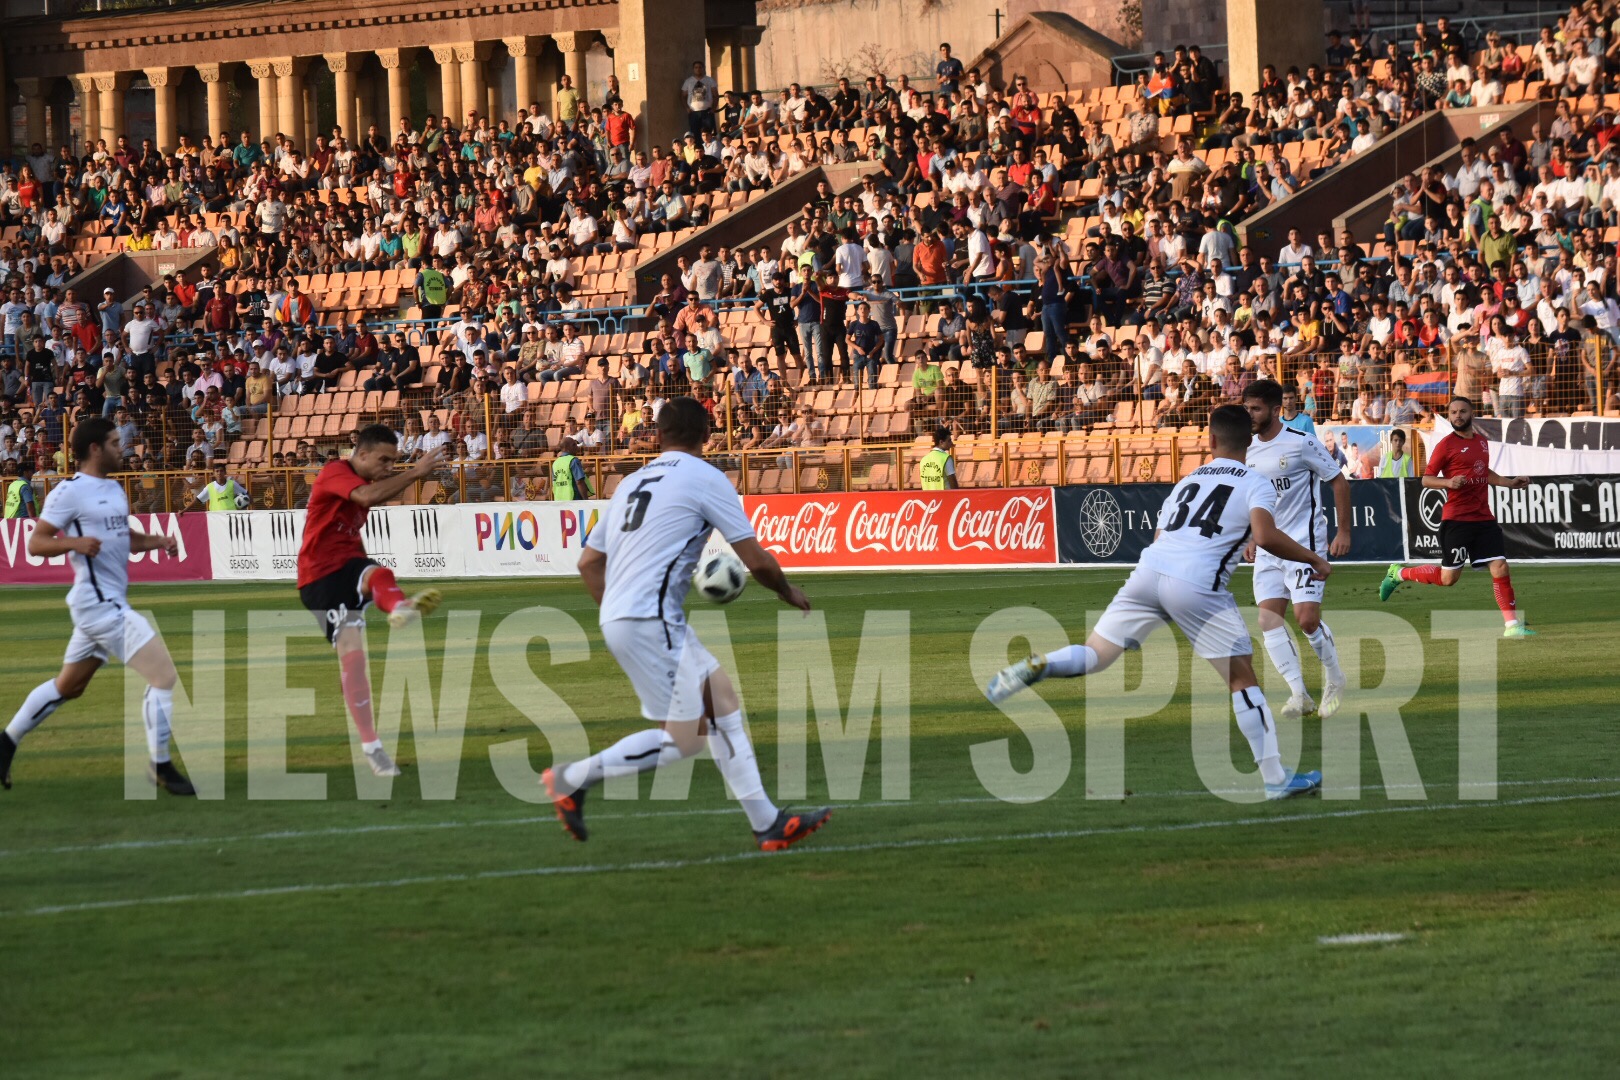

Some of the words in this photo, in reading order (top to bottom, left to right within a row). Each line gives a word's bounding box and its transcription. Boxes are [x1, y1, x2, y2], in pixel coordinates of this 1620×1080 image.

[620, 475, 665, 533] 5
[1164, 482, 1235, 539] 34
[750, 501, 841, 555] Coca-Cola
[845, 499, 943, 554] Coca-Cola
[947, 496, 1050, 552] Coca-Cola
[1554, 532, 1603, 549] FOOTBALL
[229, 559, 260, 570] SEASONS
[272, 559, 299, 569] SEASON
[414, 556, 446, 568] SEASONS
[1451, 546, 1467, 564] 20
[1295, 567, 1315, 590] 22
